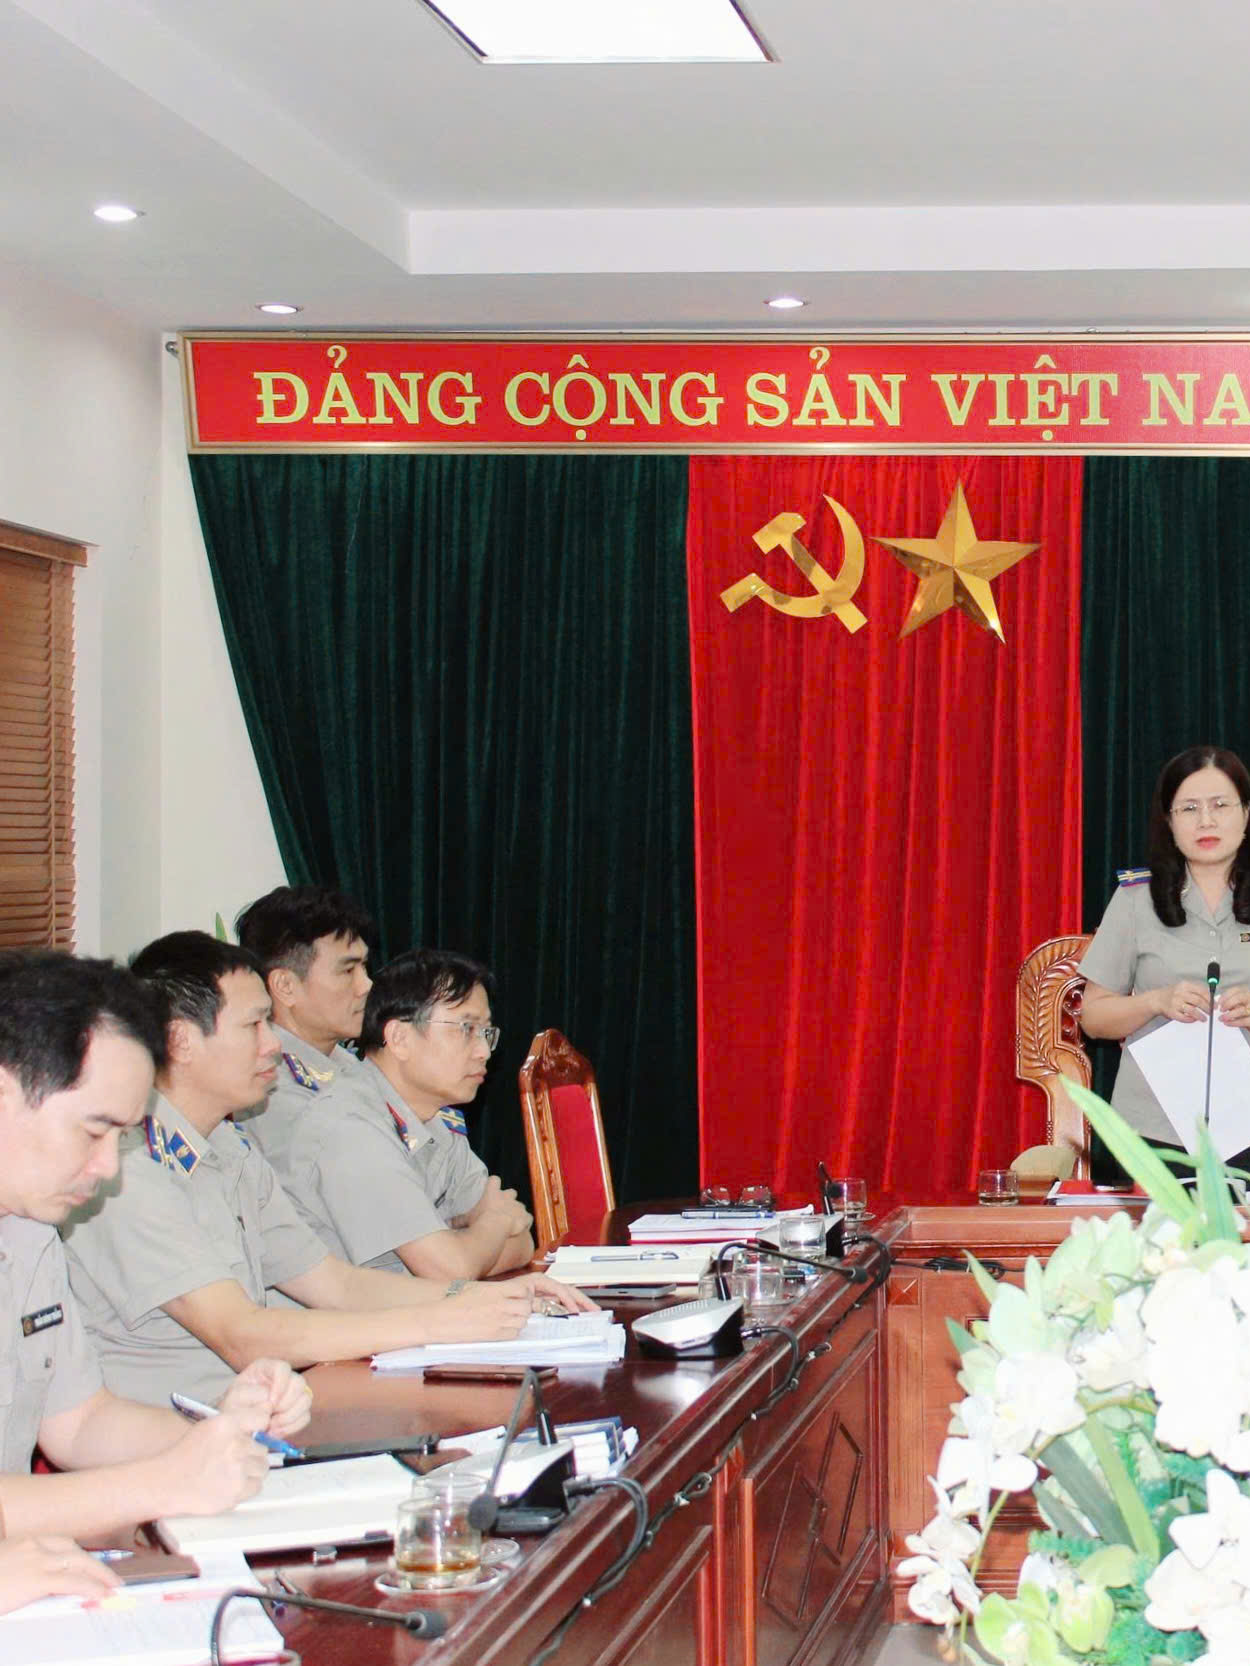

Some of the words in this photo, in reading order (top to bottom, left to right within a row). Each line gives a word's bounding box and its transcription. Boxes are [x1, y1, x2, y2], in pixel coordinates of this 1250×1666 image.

[254, 345, 482, 426] ĐẢNG
[505, 354, 725, 441] CỘNG
[746, 346, 907, 427] SẢN
[931, 354, 1119, 442] VIỆT
